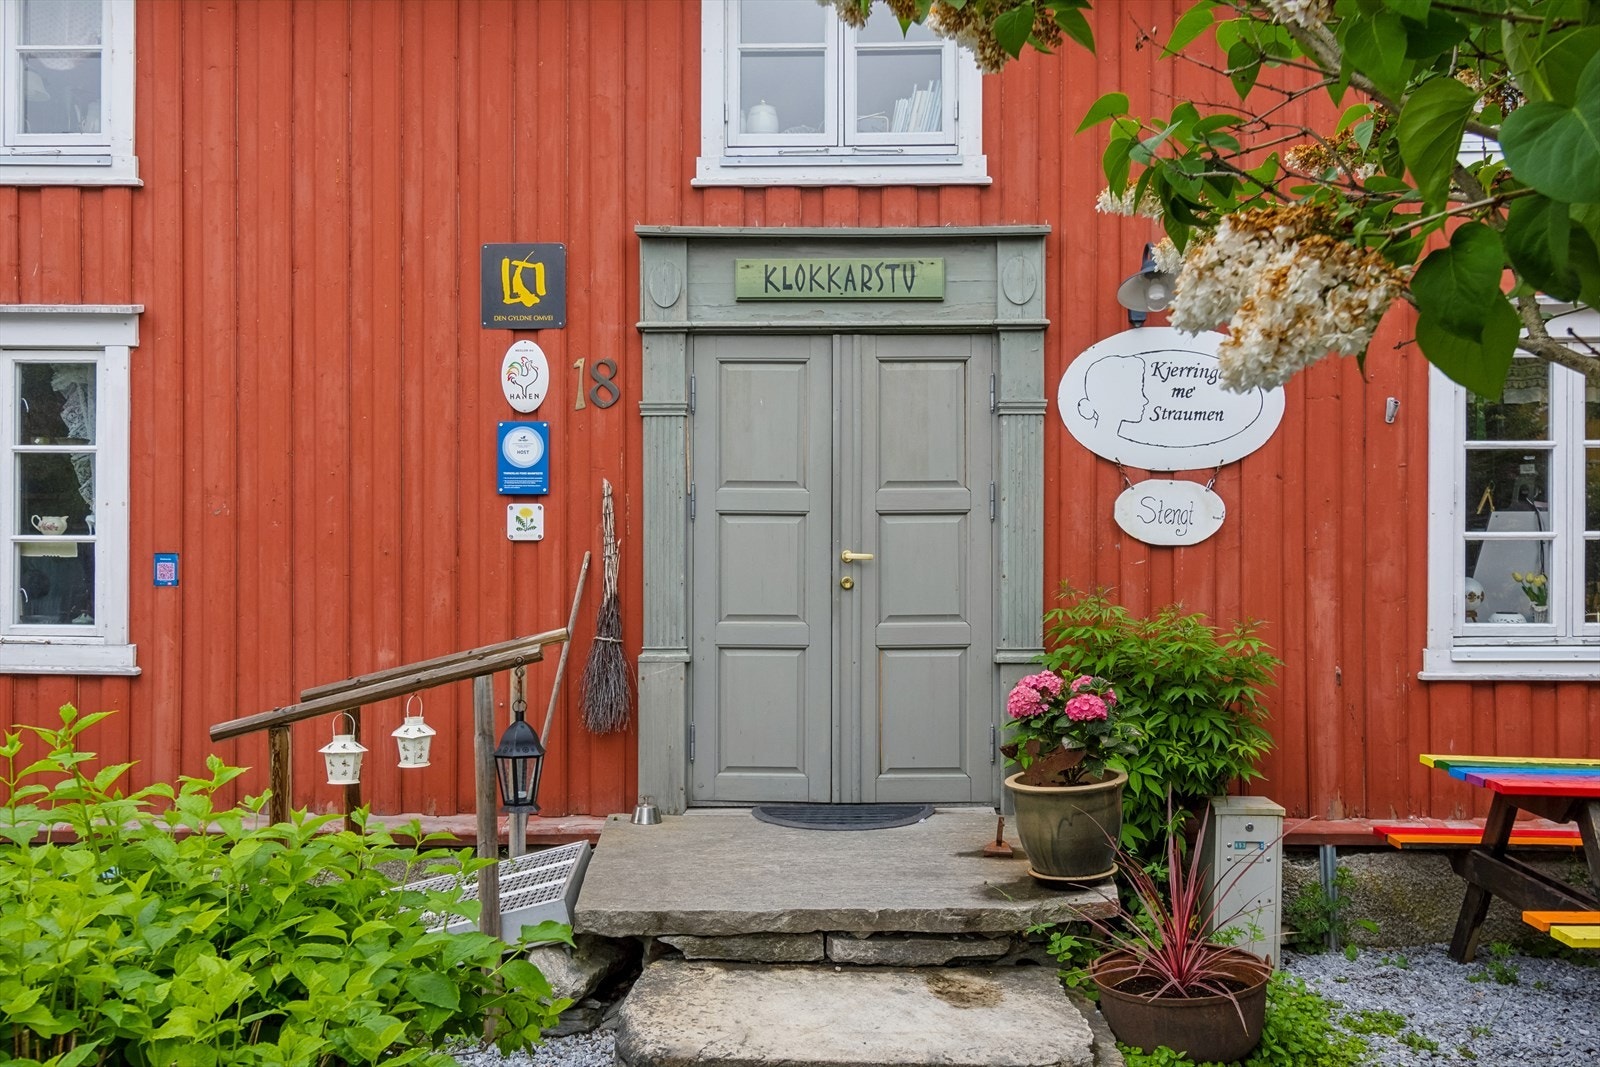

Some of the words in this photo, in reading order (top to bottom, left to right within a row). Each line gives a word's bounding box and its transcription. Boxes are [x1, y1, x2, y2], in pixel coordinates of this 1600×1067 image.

[493, 314, 507, 322] DEN
[508, 314, 532, 322] GYLDNE
[533, 314, 554, 322] OMVEI
[573, 357, 620, 411] 18
[1149, 405, 1225, 422] Straumen
[1136, 495, 1195, 537] Stengt
